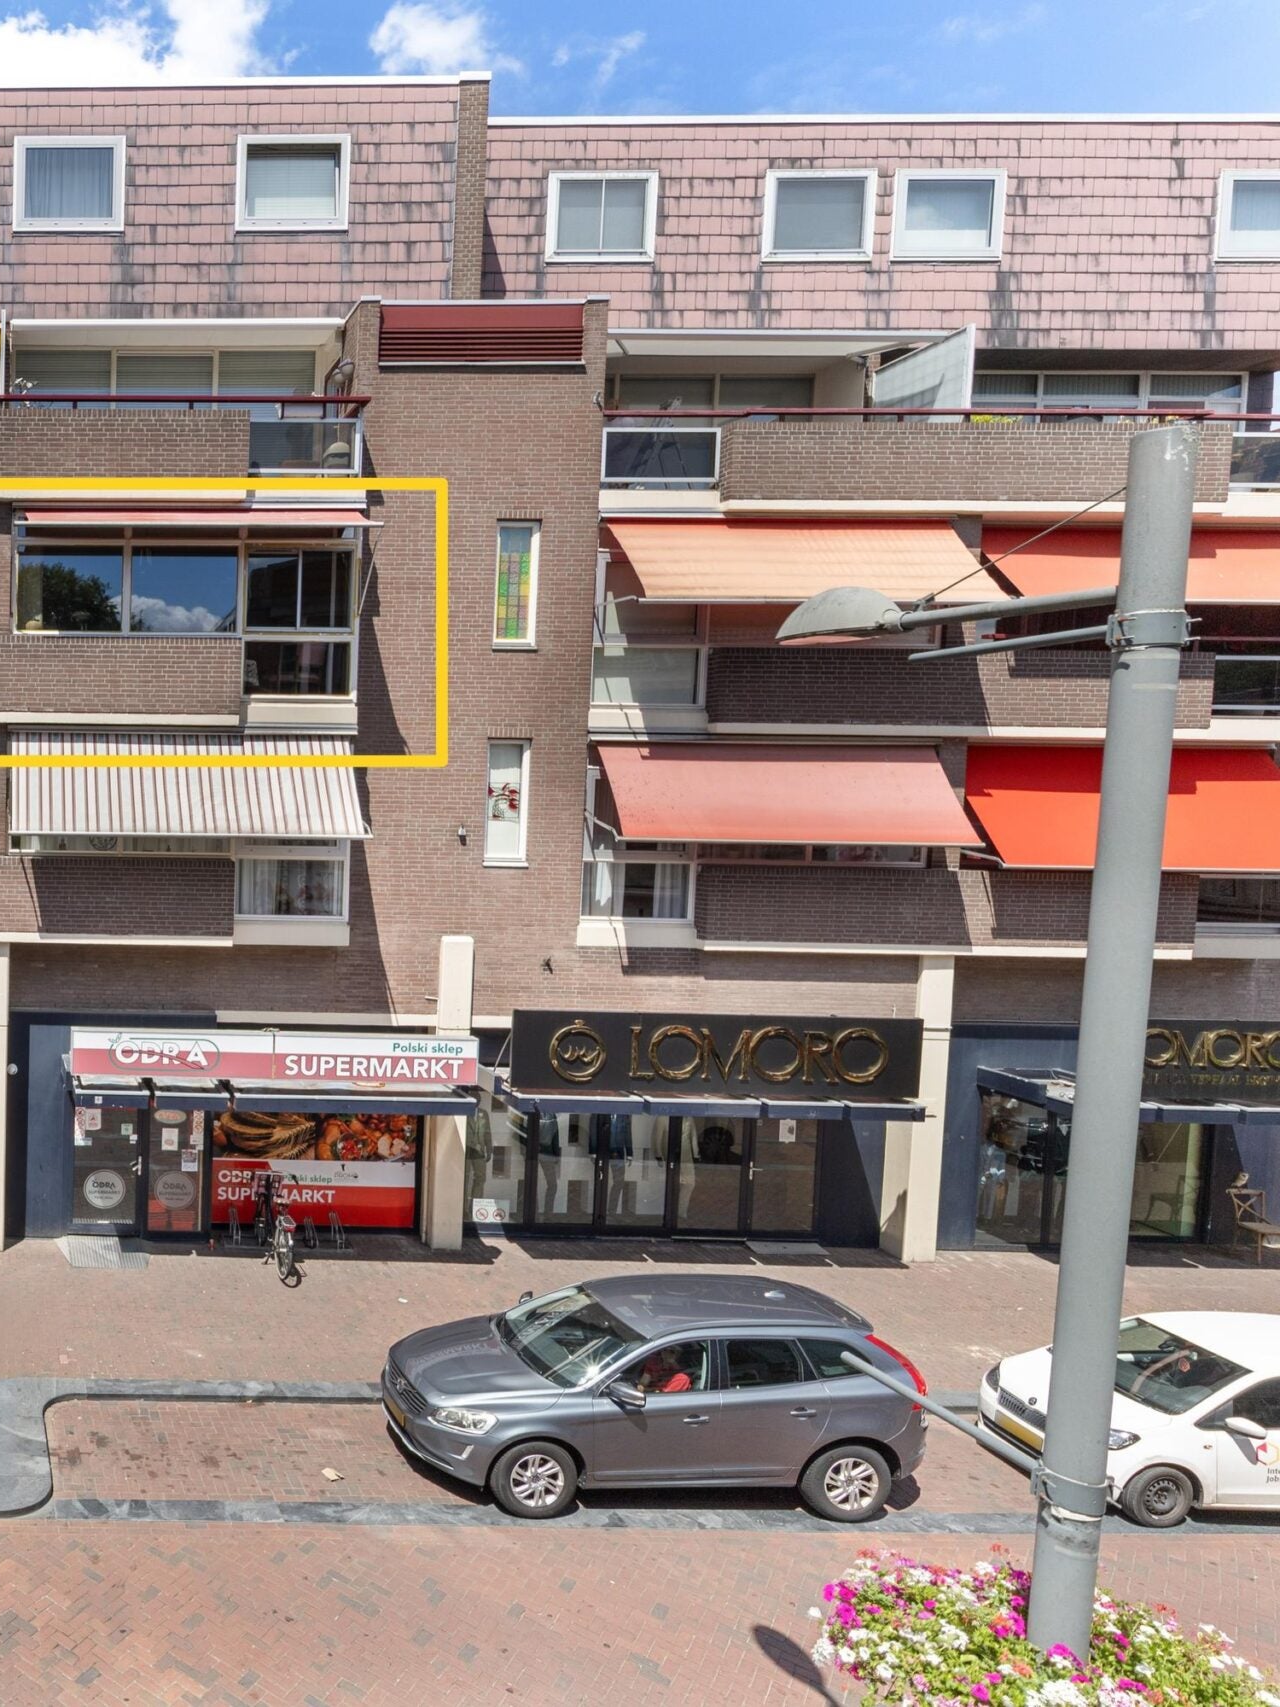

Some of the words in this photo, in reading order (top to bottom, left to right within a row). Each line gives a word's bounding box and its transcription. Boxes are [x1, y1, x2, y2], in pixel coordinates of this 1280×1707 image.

[115, 1040, 209, 1066] ODRA
[392, 1042, 428, 1054] Polski
[431, 1043, 463, 1056] sklep
[629, 1025, 889, 1083] LOMORO
[1144, 1028, 1280, 1068] OMOR
[284, 1055, 464, 1080] SUPERMARKT
[218, 1170, 253, 1183] ODR
[310, 1174, 332, 1184] sklep
[217, 1186, 336, 1203] SUPMARKT
